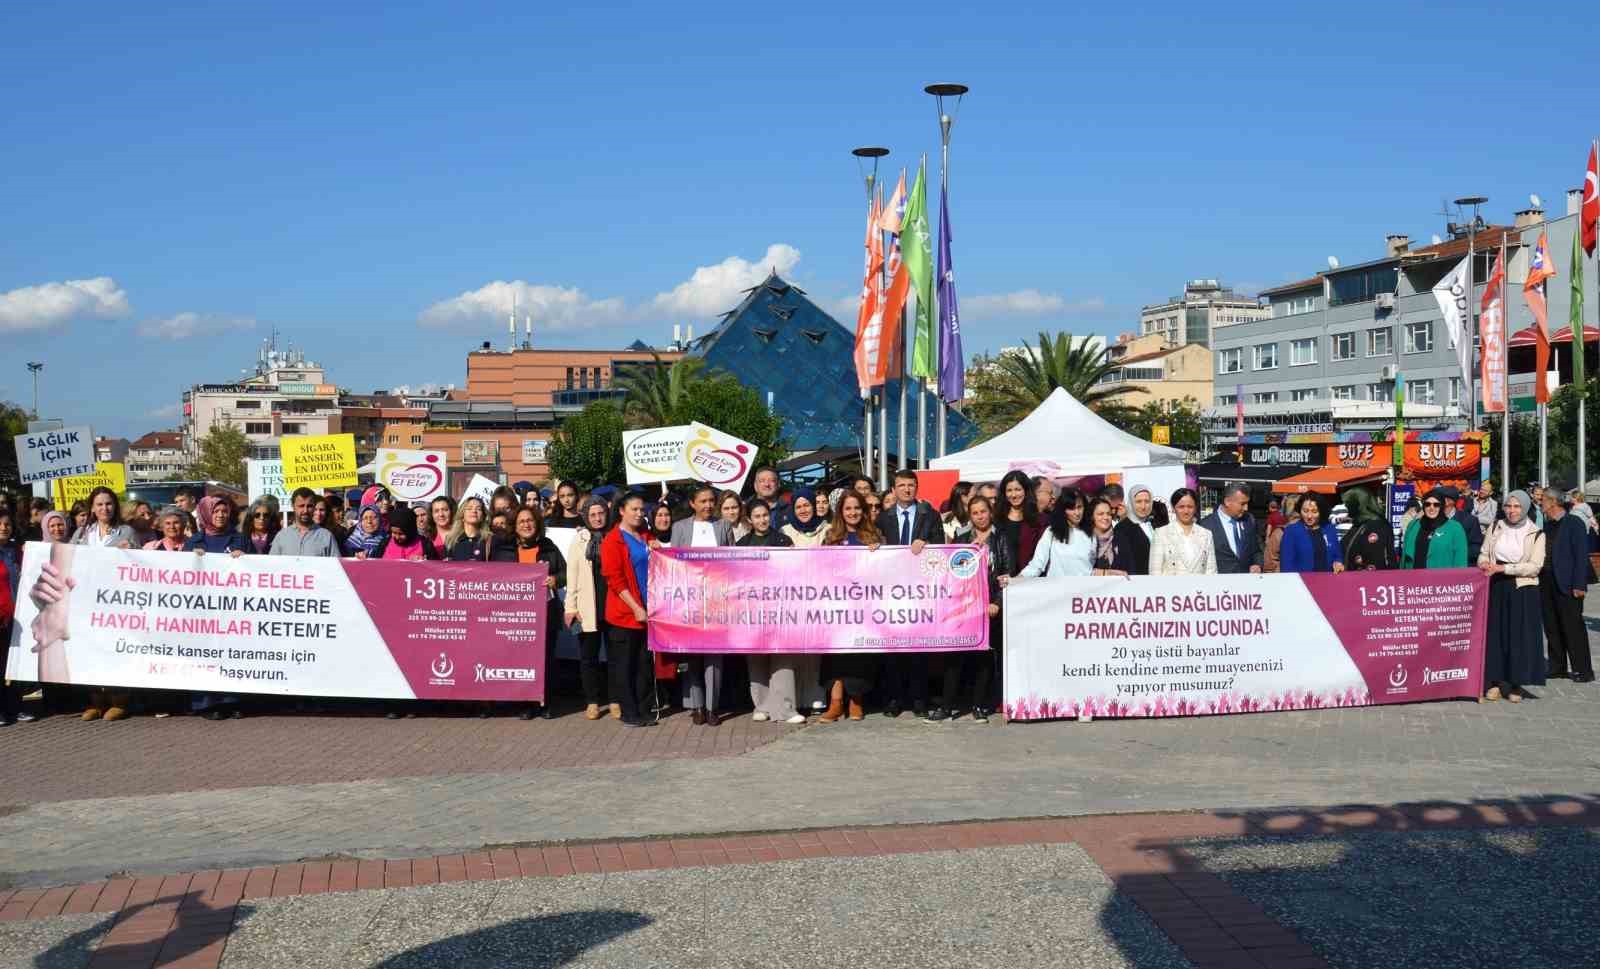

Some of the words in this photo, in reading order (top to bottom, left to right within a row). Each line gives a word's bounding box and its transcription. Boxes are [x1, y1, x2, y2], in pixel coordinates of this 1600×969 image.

[28, 431, 80, 448] SAĞLIK
[300, 443, 336, 453] SİGARA
[41, 447, 72, 463] İÇİN
[295, 452, 343, 463] KANSERİN
[1252, 449, 1268, 462] OLD
[1280, 449, 1310, 462] BERRY
[22, 467, 72, 482] HAREKET
[76, 465, 89, 473] ET
[296, 465, 307, 474] EN
[311, 462, 344, 472] BÜYÜK
[118, 563, 155, 582] TÜM
[158, 567, 250, 588] KADINLAR
[258, 573, 314, 589] ELELE
[404, 578, 445, 599] 1-31
[459, 582, 488, 591] MEME
[492, 581, 535, 592] KANSERİ
[737, 582, 883, 600] FARKINDALIĞIN
[891, 585, 952, 600] OLSUN
[1407, 586, 1434, 595] MEME
[1436, 583, 1474, 594] KANSERİ
[96, 589, 152, 610] KARŞI
[157, 592, 237, 611] KOYALIM
[243, 596, 330, 614] KANSERE
[458, 592, 521, 602] BİLİNÇLENDİRME
[1072, 597, 1166, 614] BAYANLAR
[1172, 590, 1262, 613] SAĞLIĞINIZ
[1360, 586, 1396, 607] 1-31
[90, 611, 150, 632] HAYDİ,
[156, 617, 251, 635] HANIMLAR
[258, 621, 337, 639] KETEM'E
[806, 609, 864, 624] MUTLU
[872, 609, 934, 624] OLSUN
[1064, 617, 1191, 640] PARMAĞINIZIN
[1196, 618, 1269, 637] UCUNDA!
[115, 639, 173, 656] Ücretsiz
[177, 644, 222, 658] kanser
[228, 647, 287, 661] taraması
[290, 649, 315, 666] için
[1111, 647, 1128, 659] 20
[1131, 649, 1151, 662] yaş
[1155, 646, 1183, 658] üstü
[1186, 643, 1240, 659] bayanlar
[219, 664, 288, 681] başvurun.
[486, 668, 535, 680] KETEM
[1062, 664, 1100, 677] kendi
[1105, 662, 1159, 676] kendine
[1162, 663, 1201, 674] meme
[1205, 659, 1284, 675] muayenenizi
[1431, 668, 1468, 680] KETEM
[1117, 681, 1166, 696] yapıyor
[1170, 677, 1234, 692] musunuz?
